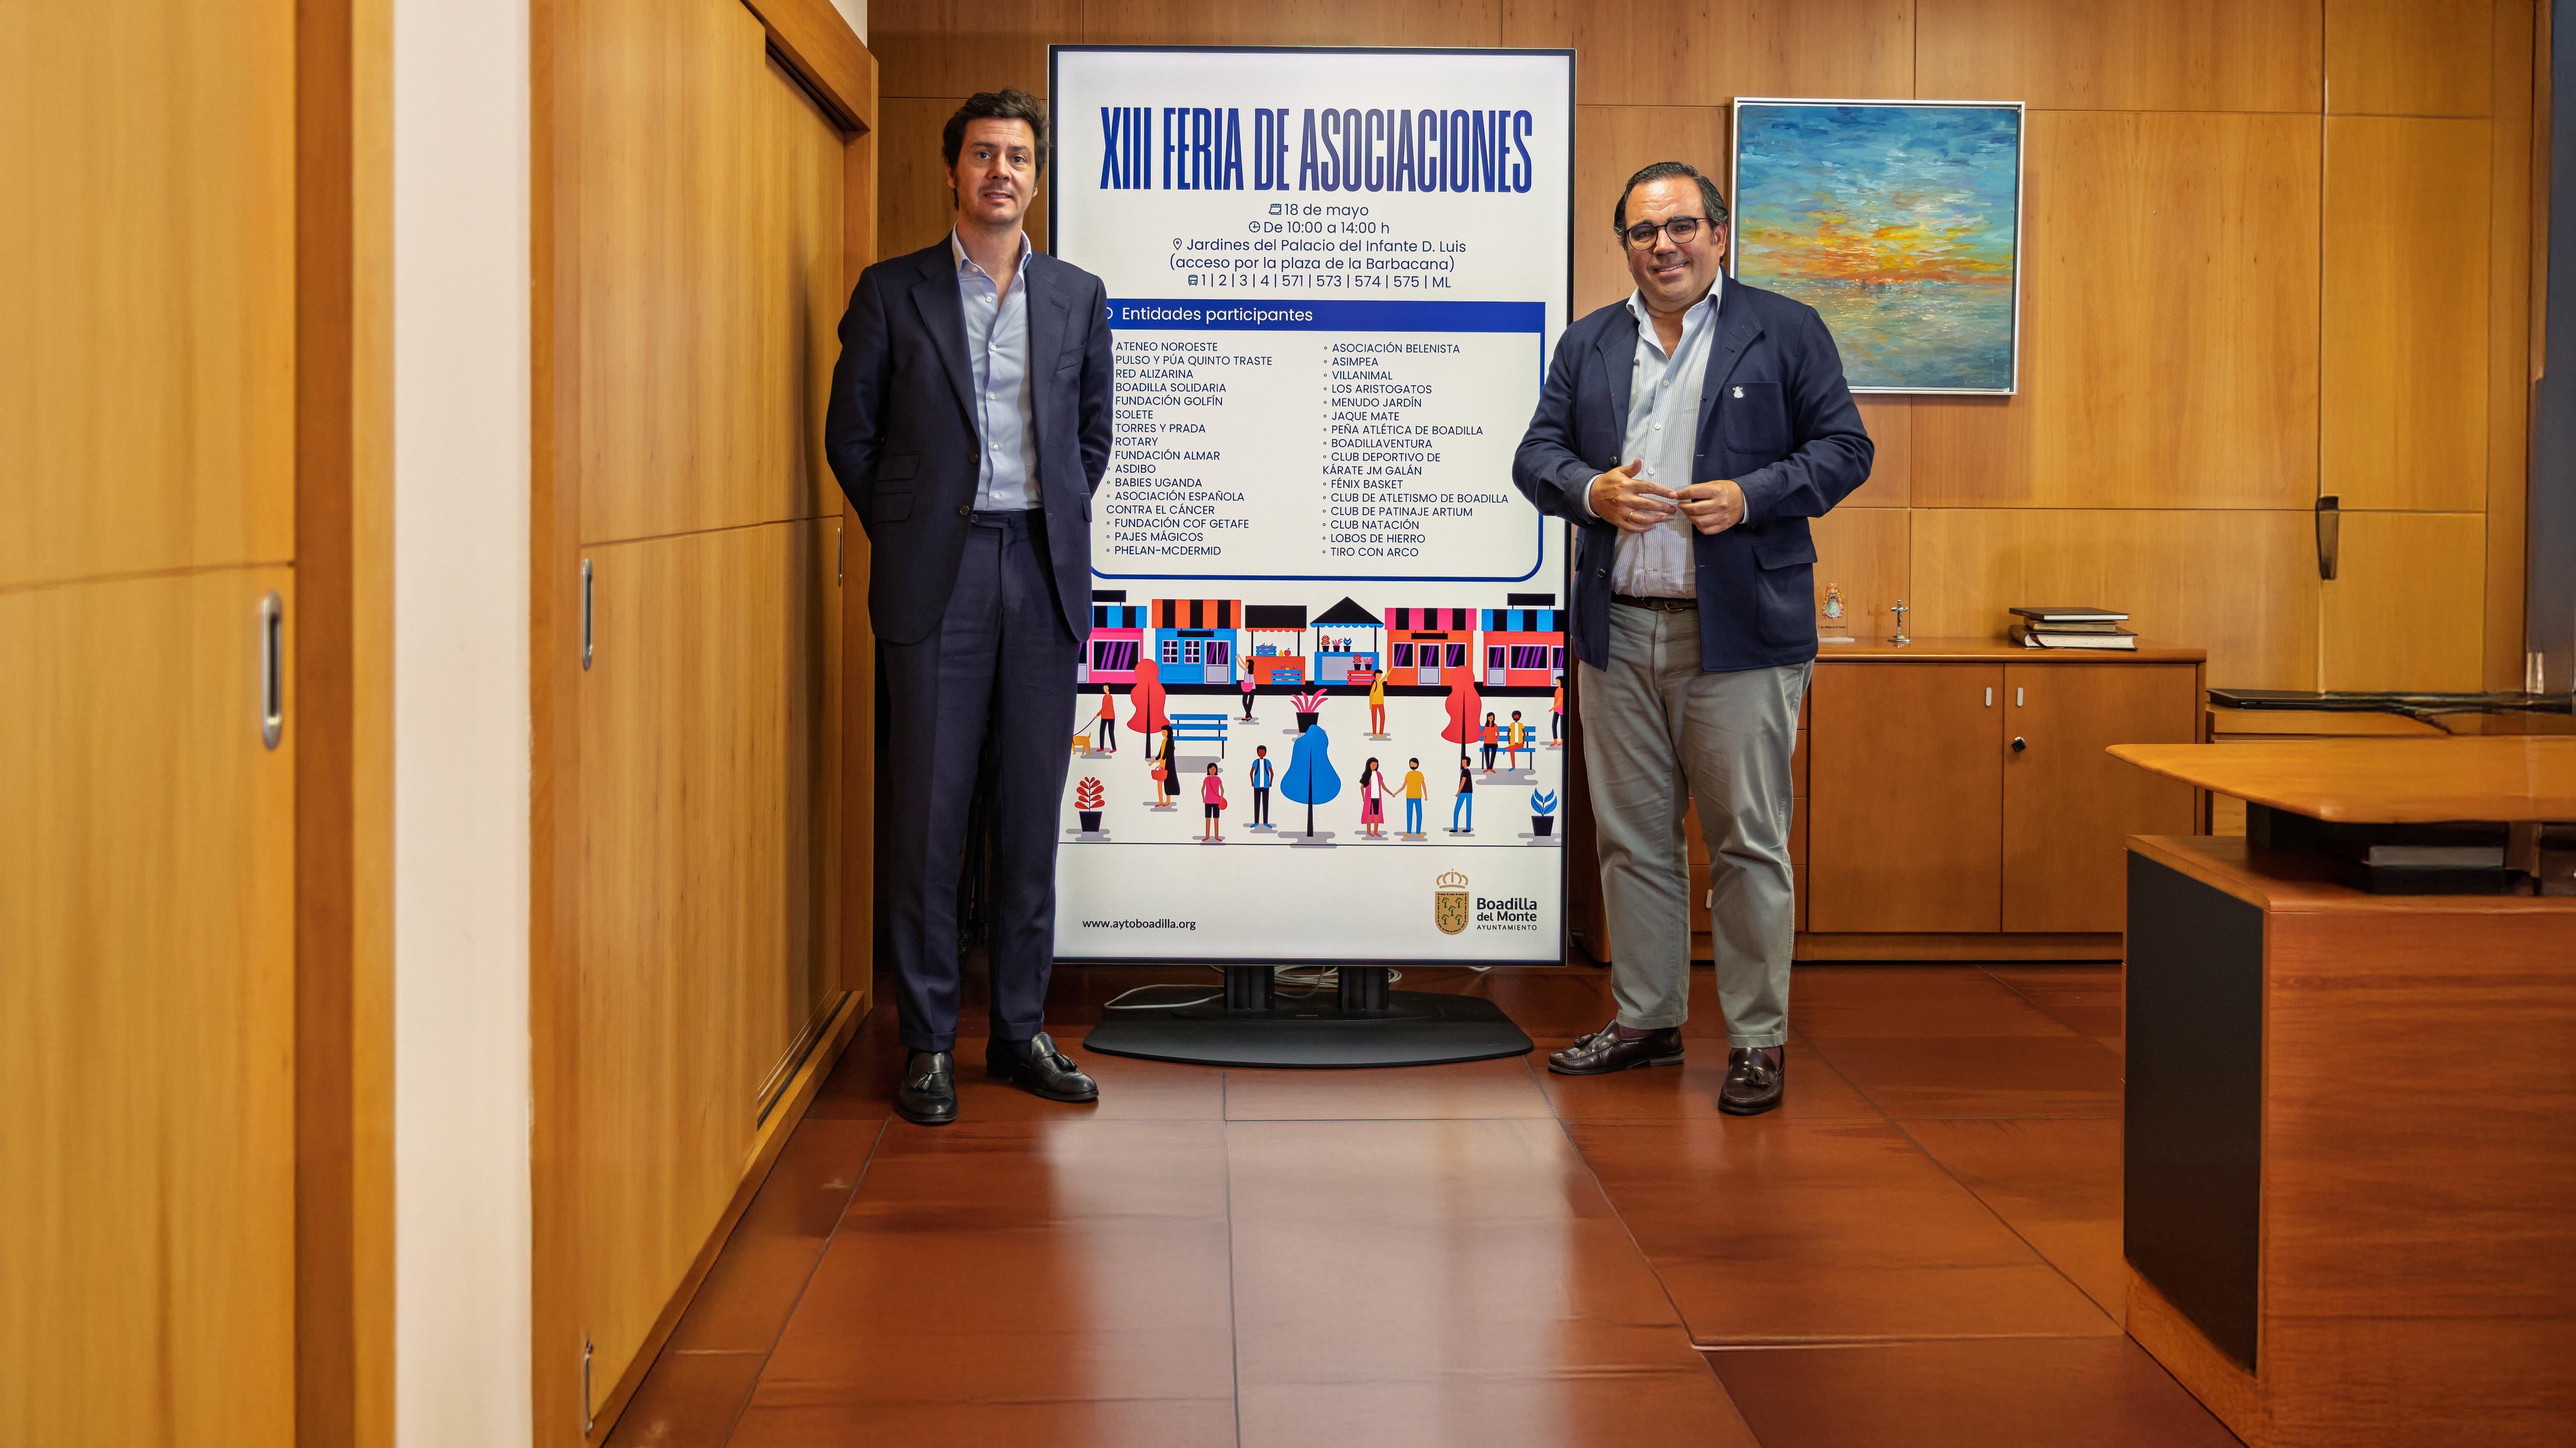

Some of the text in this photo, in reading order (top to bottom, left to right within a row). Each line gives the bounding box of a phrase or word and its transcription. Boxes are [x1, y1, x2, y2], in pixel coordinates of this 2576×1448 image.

[1100, 107, 1533, 194] XIII FERIA DE ASOCIACIONES
[1284, 203, 1369, 220] 18 de mayo
[1264, 221, 1390, 234] De 10:00 a 14:00 h
[1186, 238, 1466, 252] Jardines del Palacio del Infante D. Luis
[1170, 252, 1454, 273] (acceso por la plaza de la Barbacana)
[1201, 274, 1205, 286] 1
[1219, 274, 1227, 286] 2
[1239, 274, 1248, 287] 3
[1260, 275, 1269, 287] 4
[1282, 275, 1303, 287] 571
[1316, 275, 1342, 287] 573
[1355, 275, 1381, 288] 574
[1394, 275, 1419, 288] 575
[1432, 276, 1452, 288] ML
[1122, 306, 1313, 325] Entidades participantes
[1115, 342, 1218, 352] ATENEO NOROESTE
[1332, 342, 1460, 354] ASOCIACIÓN BELENISTA
[1115, 353, 1272, 367] PULSO Y PÚA QUINTO TRASTE
[1332, 357, 1379, 366] ASIMPEA
[1115, 369, 1193, 379] RED ALIZARINA
[1332, 370, 1393, 380] VILLANIMAL
[1115, 382, 1227, 393] BOADILLA SOLIDARIA
[1332, 384, 1432, 394] LOS ARISTOGATOS
[1115, 394, 1223, 406] FUNDACIÓN GOLFÍN
[1332, 396, 1421, 407] MENUDO JARDÍN
[1115, 409, 1153, 419] SOLETE
[1331, 411, 1400, 422] JAQUE MATE
[1115, 423, 1206, 433] TORRES Y PRADA
[1331, 423, 1483, 435] PEÑA ATLÉTICA DE BOADILLA
[1115, 437, 1158, 447] ROTARY
[1331, 439, 1432, 449] BOADILLAVENTURA
[1115, 448, 1220, 461] FUNDACIÓN ALMAR
[1331, 452, 1440, 462] CLUB DEPORTIVO DE
[1115, 464, 1156, 473] ASDIBO
[1323, 463, 1422, 475] KÁRATE JM GALÁN
[1115, 477, 1202, 487] BABIES UGANDA
[1331, 477, 1403, 489] FÉNIX BASKET
[1114, 489, 1245, 501] ASOCIACIÓN ESPAÑOLA
[1331, 493, 1509, 503] CLUB DE ATLETISMO DE BOADILLA
[1106, 502, 1215, 515] CONTRA EL CÁNCER
[1331, 506, 1473, 517] CLUB DE PATINAJE ARTIUM
[1115, 517, 1249, 529] FUNDACIÓN COF GETAFE
[1330, 518, 1419, 530] CLUB NATACIÓN
[1114, 530, 1203, 542] PAJES MÁGICOS
[1331, 533, 1425, 543] LOBOS DE HIERRO
[1114, 545, 1221, 556] PHELAN-MCDERMID
[1330, 547, 1419, 557] TIRO CON ARCO
[1477, 897, 1537, 910] Boadilla
[1476, 910, 1537, 922] del Monte
[1082, 918, 1196, 931] www.aytoboadilla.org
